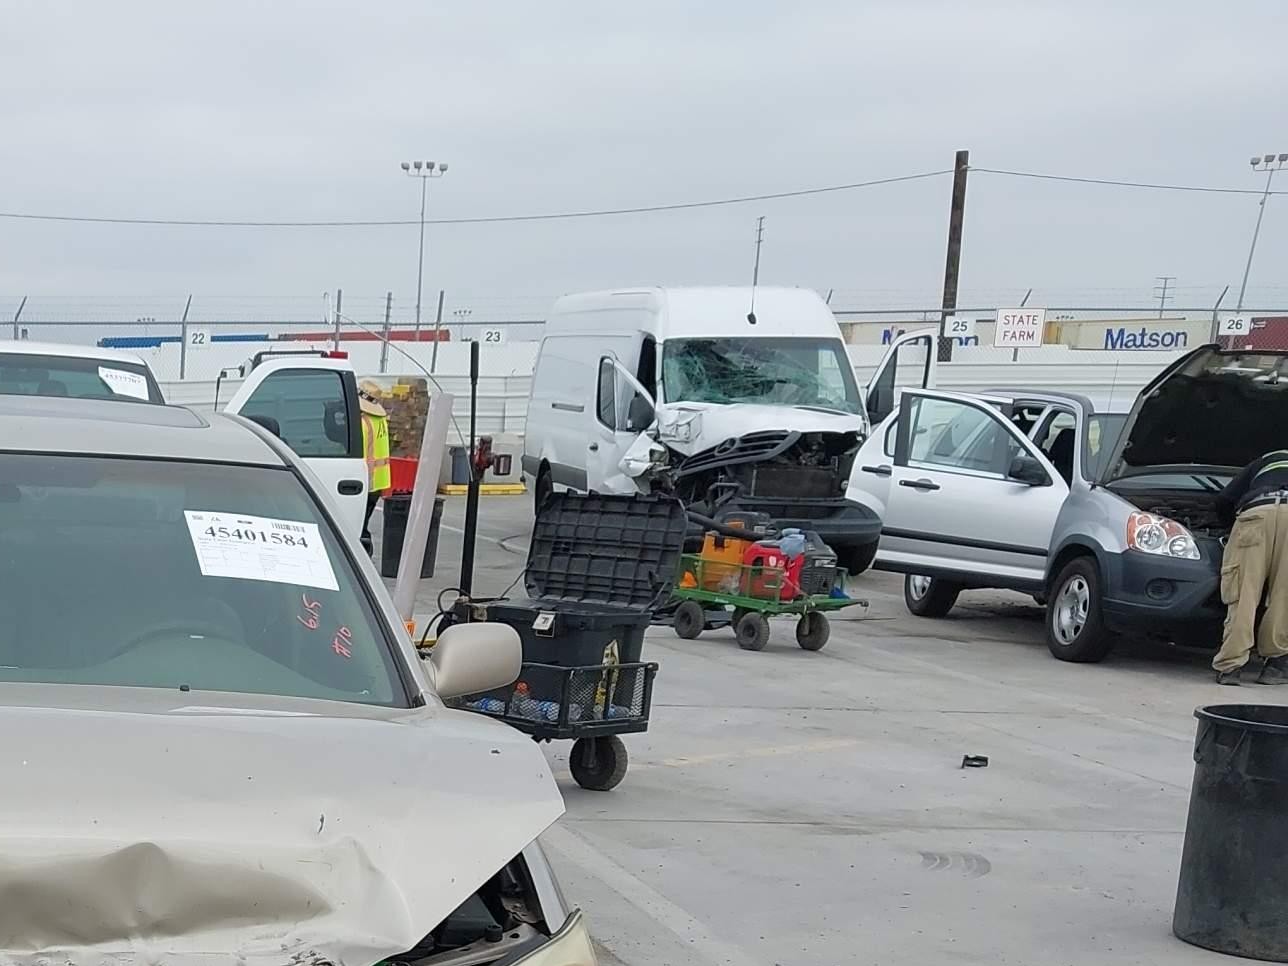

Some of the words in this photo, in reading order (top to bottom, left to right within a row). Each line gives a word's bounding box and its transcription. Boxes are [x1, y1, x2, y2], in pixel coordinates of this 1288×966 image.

[1002, 315, 1039, 325] STATE
[1227, 319, 1243, 330] 26
[952, 321, 968, 332] 25
[192, 333, 205, 344] 22
[486, 331, 501, 342] 23
[1002, 331, 1036, 341] FARM
[1105, 327, 1188, 350] Matson
[205, 526, 309, 548] 45401584
